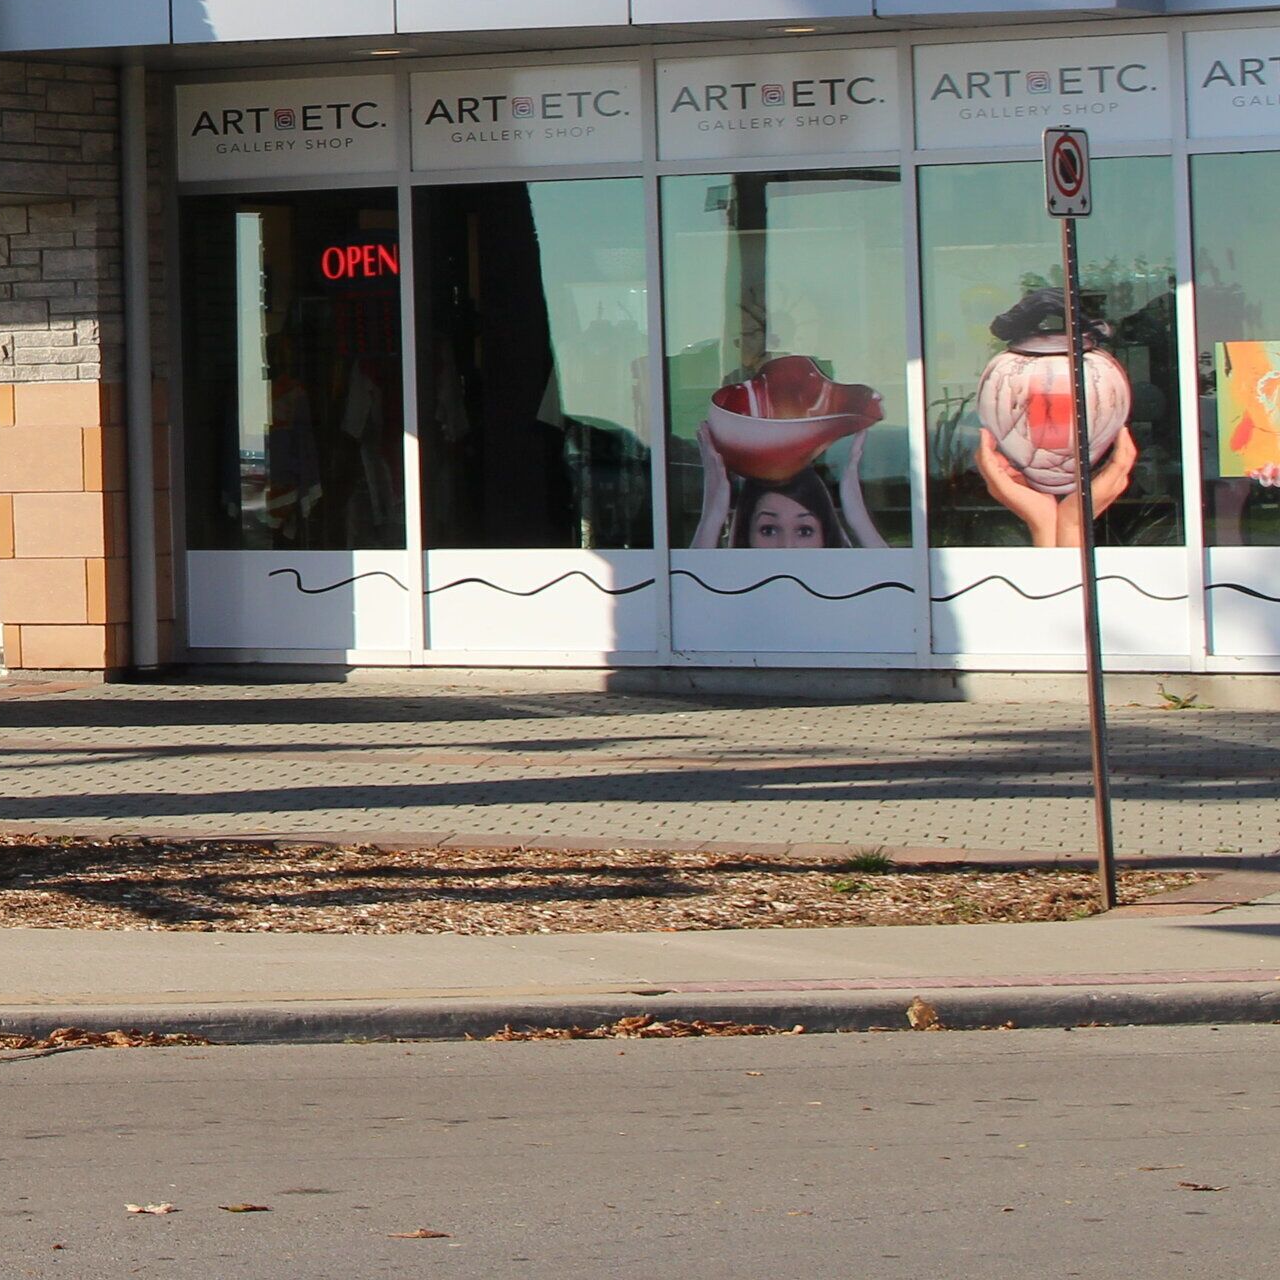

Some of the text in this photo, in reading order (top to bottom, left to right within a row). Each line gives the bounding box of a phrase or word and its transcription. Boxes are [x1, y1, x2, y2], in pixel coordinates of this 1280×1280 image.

[671, 77, 884, 113] ART ETC.
[931, 64, 1156, 100] ART ETC.
[425, 90, 629, 125] ART ETC.
[959, 102, 1119, 120] GALLERY SHOP
[1232, 94, 1280, 108] GAL
[192, 102, 386, 136] ART ETC.
[697, 114, 849, 132] GALLERY SHOP
[215, 137, 354, 154] GALLERY SHOP
[450, 125, 596, 144] GALLERY SHOP
[321, 244, 400, 279] OPEN
